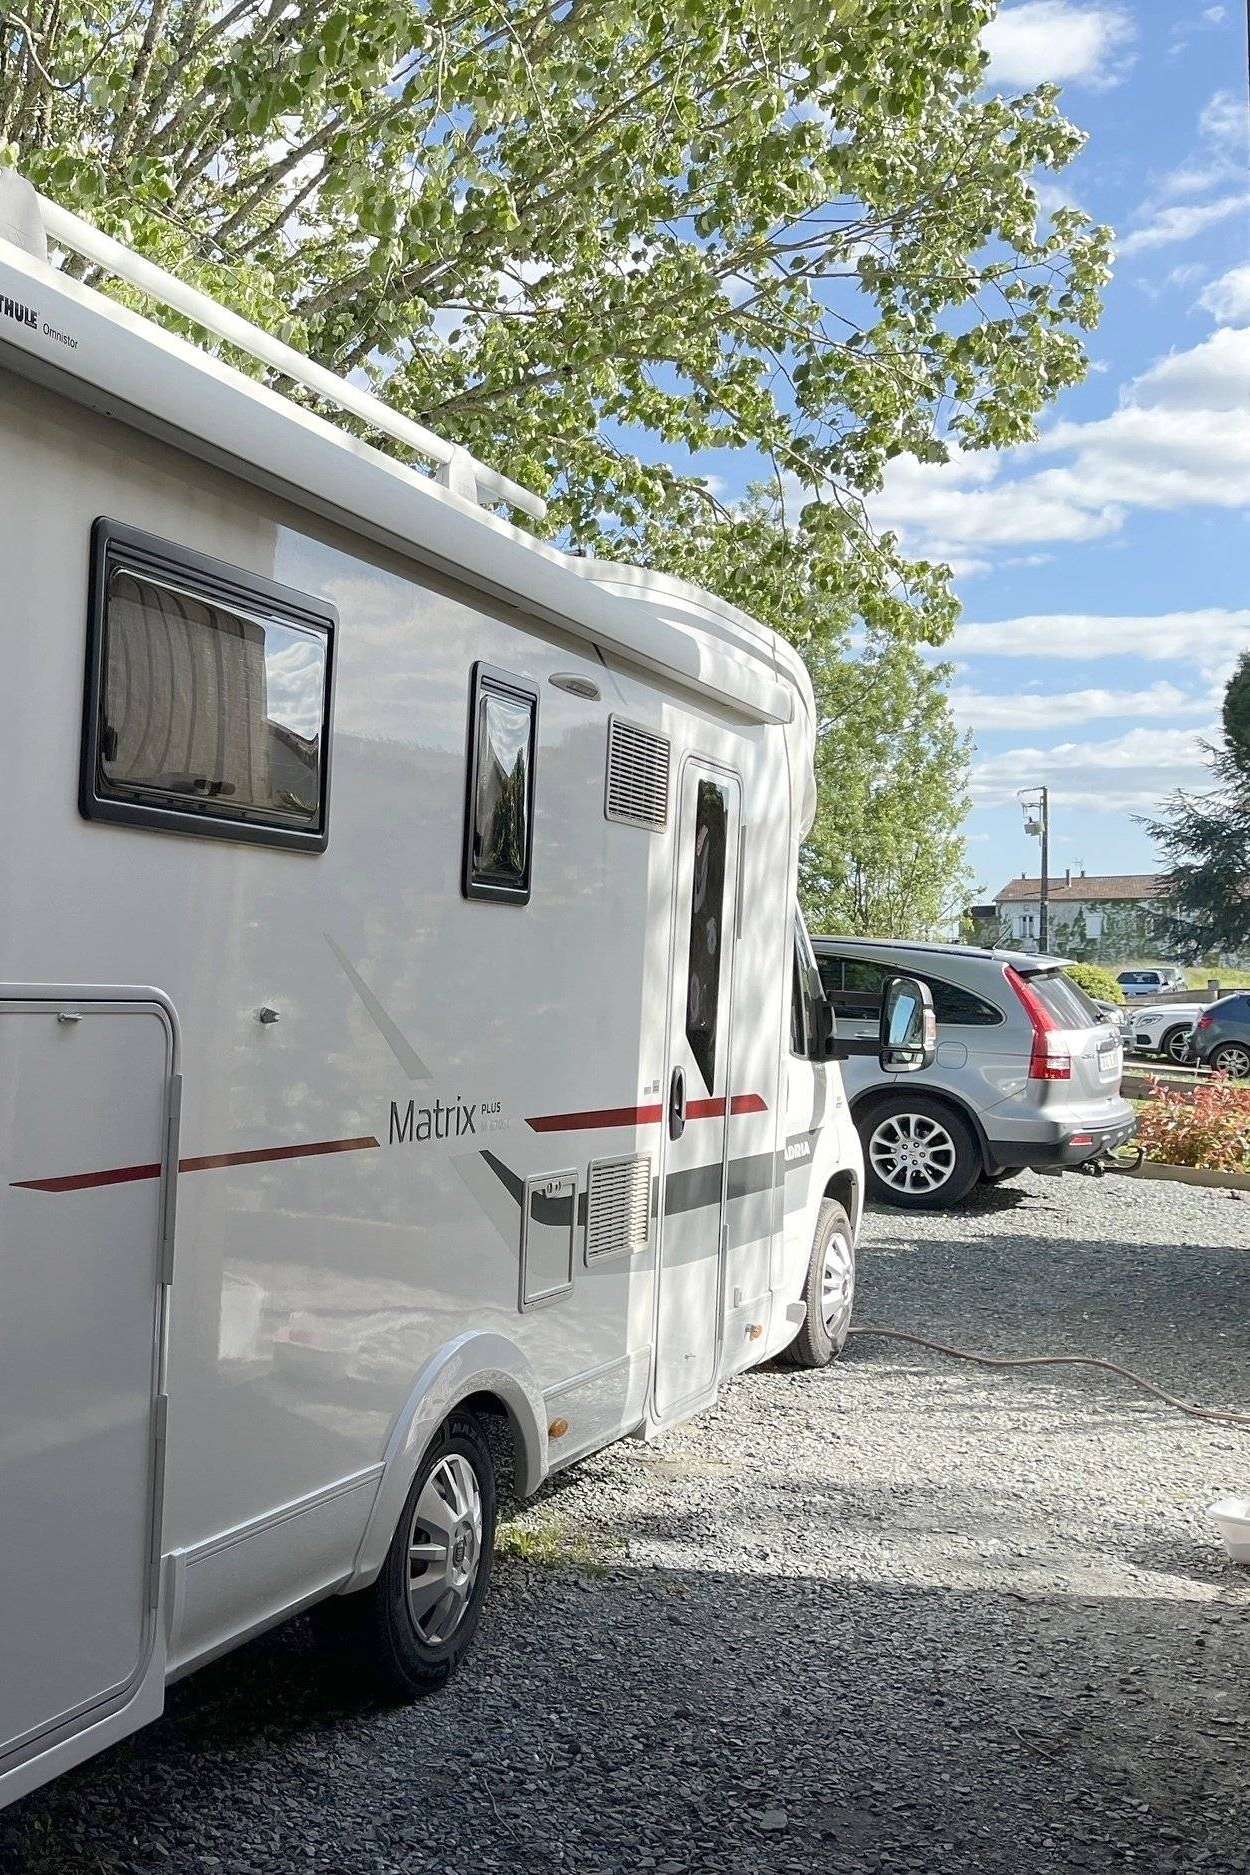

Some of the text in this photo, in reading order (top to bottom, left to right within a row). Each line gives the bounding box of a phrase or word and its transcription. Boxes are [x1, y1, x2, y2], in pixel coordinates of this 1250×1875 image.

[43, 323, 78, 349] Omnistor
[389, 1096, 501, 1145] Matrix PLUS
